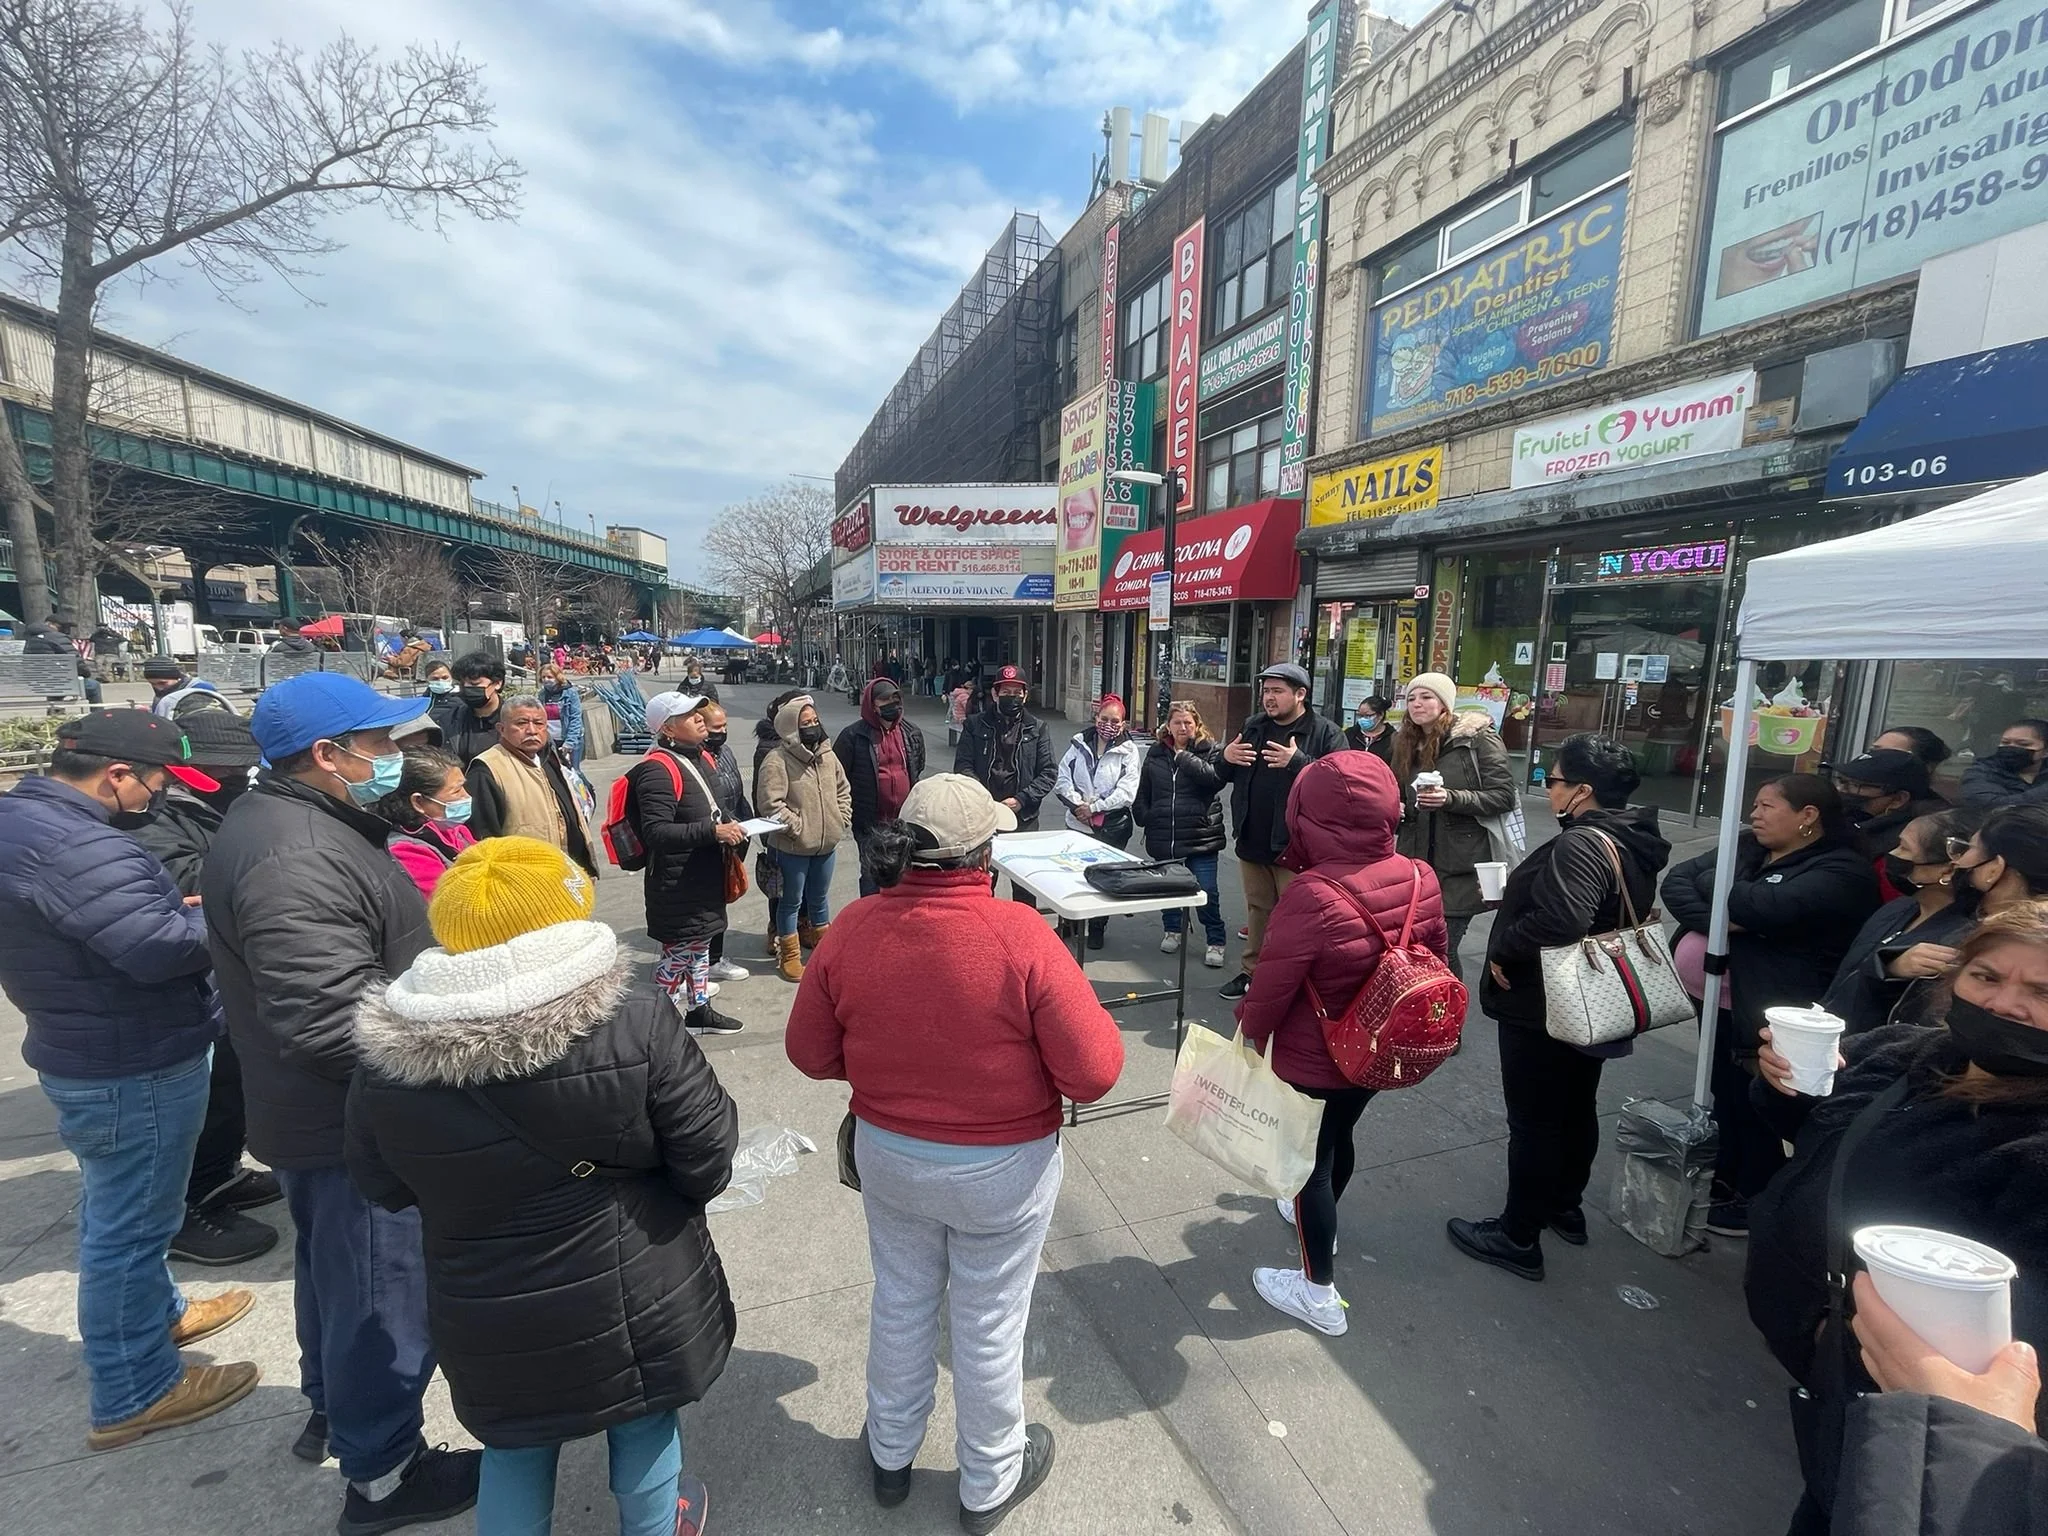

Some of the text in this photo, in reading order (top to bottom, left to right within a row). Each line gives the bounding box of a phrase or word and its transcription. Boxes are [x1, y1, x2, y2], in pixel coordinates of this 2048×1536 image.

[1806, 8, 2048, 145] Ortodon
[1299, 18, 1331, 244] DENTIST
[1742, 68, 2048, 210] Frenillos para Adu
[1875, 110, 2048, 199] Invisalig
[1824, 152, 2048, 265] (718)458-9
[1383, 205, 1612, 338] PEDIATRIC
[1474, 260, 1571, 319] Dentist
[1452, 289, 1553, 338] Special Attention to
[1487, 275, 1609, 333] CHILDREN & TEENS
[1528, 309, 1578, 336] Preventive
[1202, 315, 1284, 376] CALL FOR APPOINTMENT
[1286, 261, 1305, 431] ADULTS
[1295, 238, 1318, 436] CHILDREN
[1467, 343, 1505, 367] Laughing
[1531, 325, 1572, 347] Sealants
[1172, 241, 1195, 502] BRACES
[1202, 342, 1281, 395] 718-779-2626
[1477, 361, 1493, 374] Gas
[1062, 392, 1104, 437] DENTIST
[1520, 386, 1746, 460] Fruitti Yummi
[1061, 447, 1104, 487] CHILDREN
[1285, 441, 1302, 463] 718
[1545, 432, 1694, 477] FROZEN YOGURT
[1844, 455, 1948, 487] 103-06
[1341, 458, 1434, 507] NAILS
[894, 504, 1057, 533] Walgreens
[878, 549, 1020, 560] STORE & OFFICE SPACE
[879, 560, 1021, 573] FOR RENT 516.466.8114
[1132, 551, 1164, 571] CHINA
[910, 586, 949, 595] ALIENTO
[953, 586, 963, 594] DE
[966, 586, 988, 595] VIDA
[991, 586, 1008, 595] INC.
[1115, 578, 1148, 592] COMIDA
[1178, 573, 1186, 584] Y
[1186, 568, 1222, 583] LATINA
[1120, 596, 1152, 606] ESPECIALIDA
[1401, 622, 1412, 678] NAILS
[1431, 588, 1454, 675] OPENING
[1518, 645, 1529, 658] A
